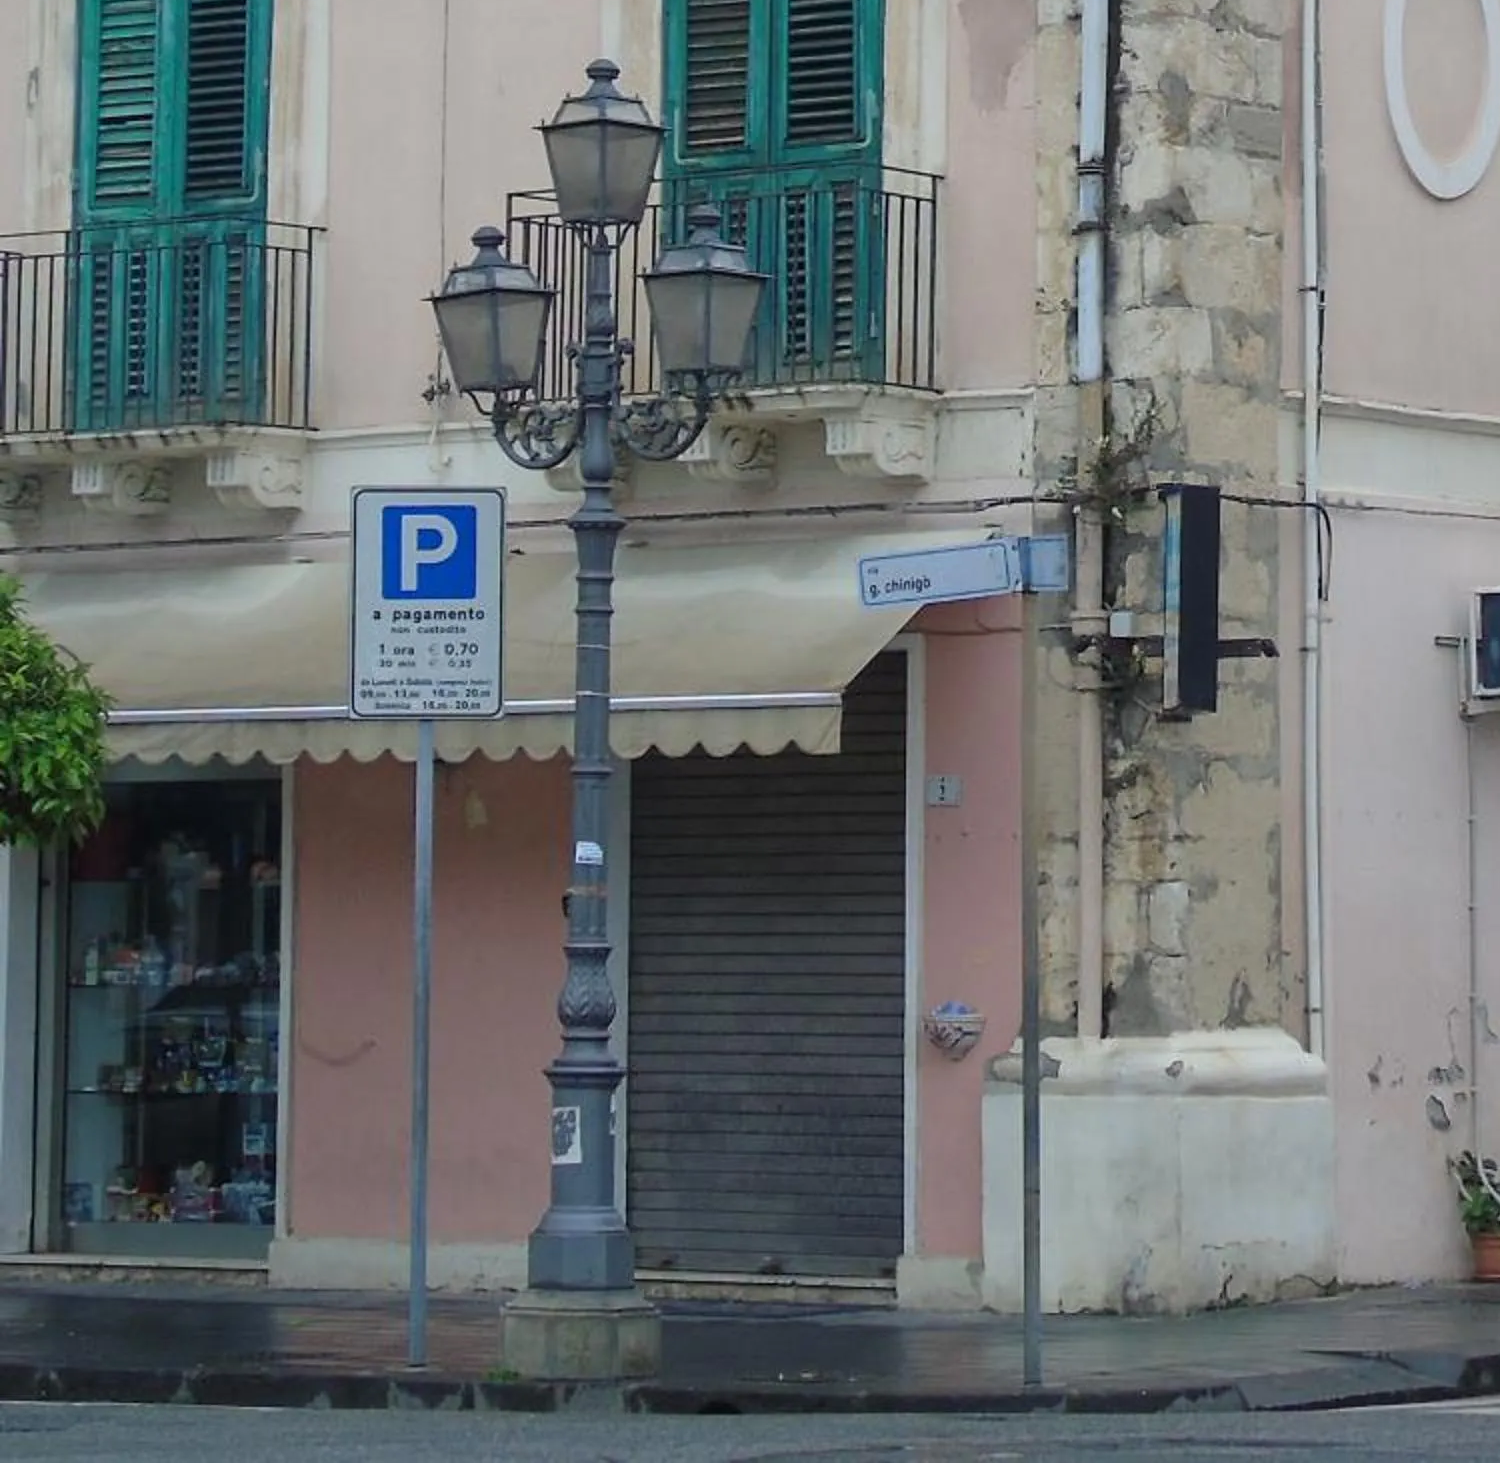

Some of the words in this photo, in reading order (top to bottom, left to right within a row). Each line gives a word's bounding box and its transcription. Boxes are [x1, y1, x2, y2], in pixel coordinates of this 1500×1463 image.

[401, 514, 458, 591] P
[373, 610, 382, 620] a
[392, 608, 485, 623] pagamento
[393, 645, 415, 655] ora
